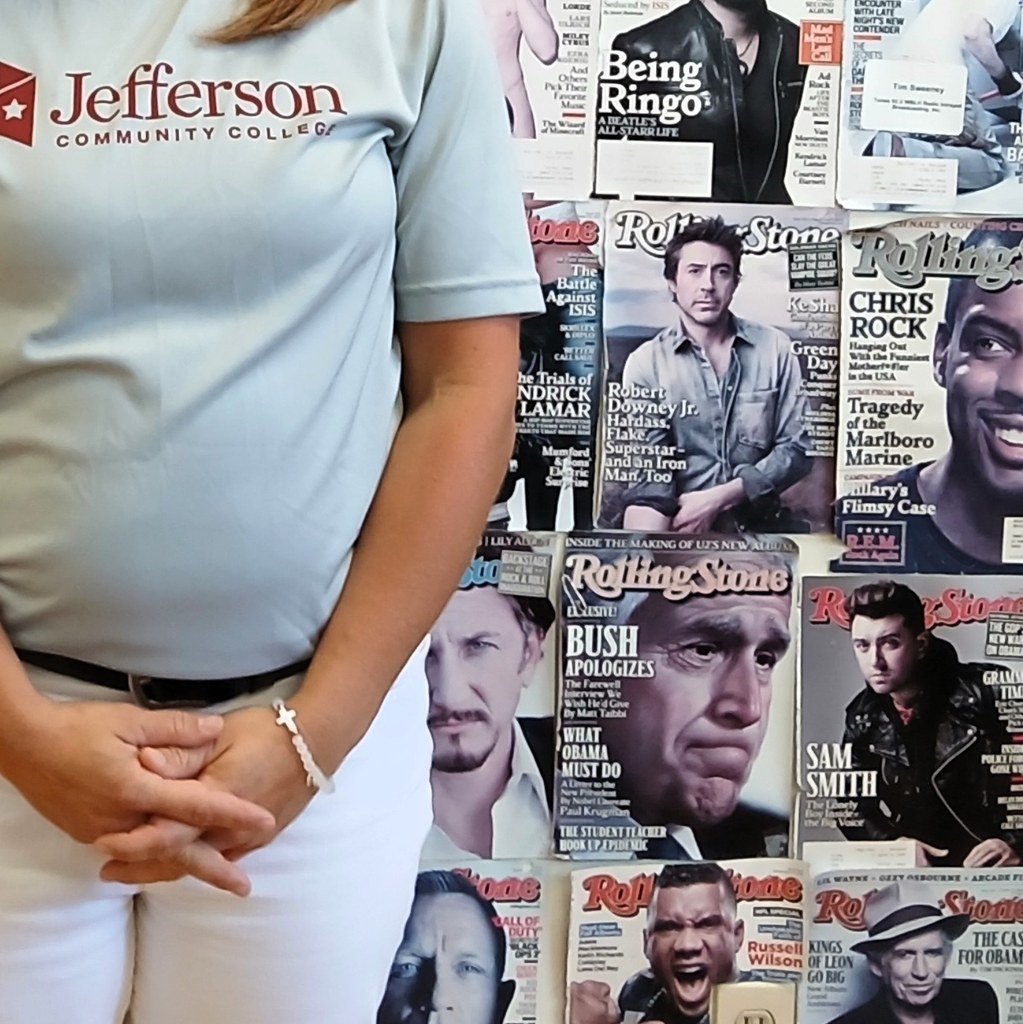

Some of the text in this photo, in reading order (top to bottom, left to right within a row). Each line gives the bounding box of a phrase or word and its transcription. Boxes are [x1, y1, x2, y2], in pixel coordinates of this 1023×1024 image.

[562, 3, 591, 11] LORDE
[854, 0, 902, 8] ENCOUNTER
[854, 8, 895, 17] WITH LATE
[853, 17, 904, 26] NIGHT'S NEW
[853, 25, 900, 34] CONTENDER
[599, 49, 703, 92] Being
[49, 62, 348, 125] Jefferson
[599, 82, 705, 125] Ringo
[55, 127, 216, 149] COMMUNITY
[571, 264, 598, 277] The
[556, 278, 597, 291] Battle
[545, 292, 596, 304] Against
[849, 292, 934, 314] CHRIS
[568, 304, 596, 316] ISIS
[850, 317, 927, 339] ROCK
[790, 343, 838, 357] Green
[849, 342, 907, 353] Hanging Out
[807, 355, 838, 371] Day
[607, 382, 667, 399] Robert
[520, 401, 591, 418] LAMAR
[607, 399, 699, 417] Downey Jr.
[847, 397, 925, 420] Tragedy
[846, 418, 887, 430] of the
[845, 431, 935, 450] Marlboro
[605, 457, 687, 470] and an Iron
[845, 449, 913, 467] Marine
[643, 469, 671, 482] Too
[841, 501, 936, 518] Flimsy Case
[565, 537, 603, 548] INSIDE
[605, 538, 626, 549] THE
[627, 538, 676, 551] MAKING
[678, 540, 693, 551] OF
[721, 540, 749, 552] NEW
[566, 625, 640, 658] BUSH
[565, 660, 656, 678] APOLOGIZES
[563, 727, 601, 744] WHAT
[562, 744, 609, 761] OBAMA
[806, 743, 854, 770] SAM
[561, 762, 622, 779] MUST DO
[806, 771, 878, 799] SMITH
[748, 941, 803, 955] Russell
[808, 940, 843, 955] KINGS
[748, 954, 803, 968] Wilson
[808, 955, 854, 968] OF LEON
[807, 971, 845, 983] GO BIG
